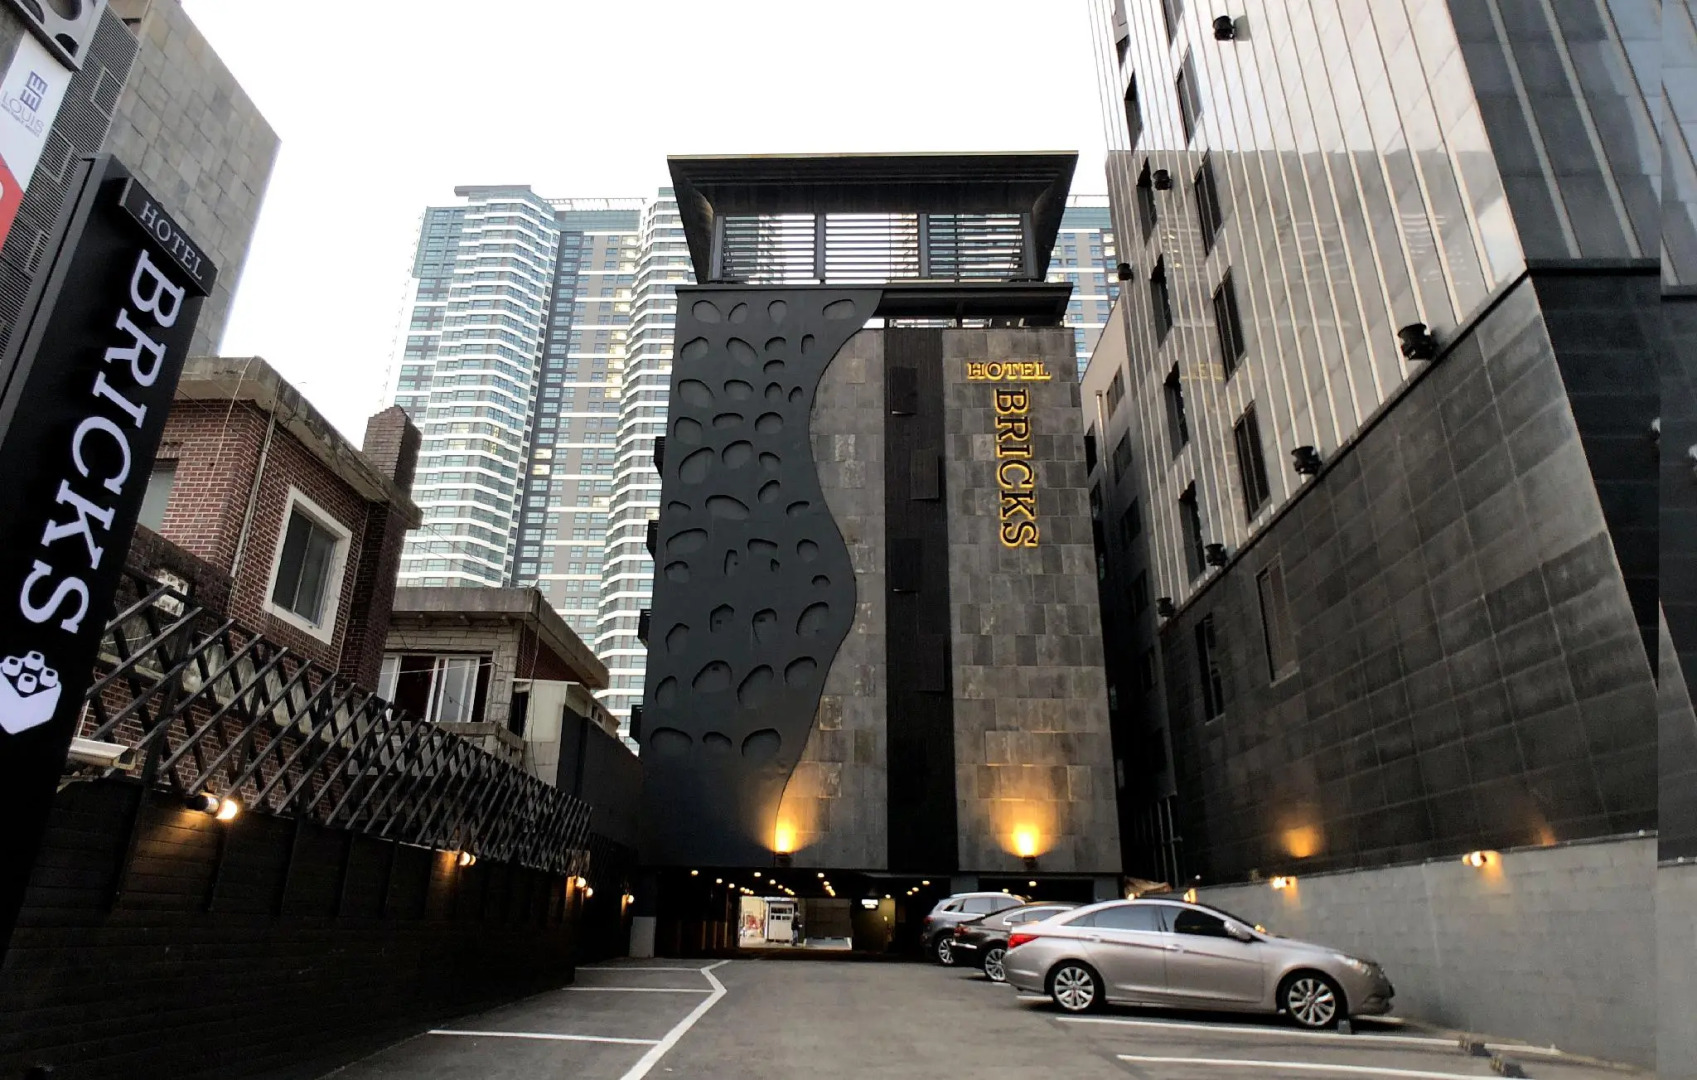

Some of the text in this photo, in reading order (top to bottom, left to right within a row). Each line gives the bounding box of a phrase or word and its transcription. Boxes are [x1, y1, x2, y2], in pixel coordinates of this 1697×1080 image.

[2, 91, 44, 133] LOUIS
[139, 201, 203, 280] HOTEL
[967, 361, 1051, 380] HOTEL
[20, 250, 185, 633] BRICKS
[994, 388, 1038, 547] BRICKS
